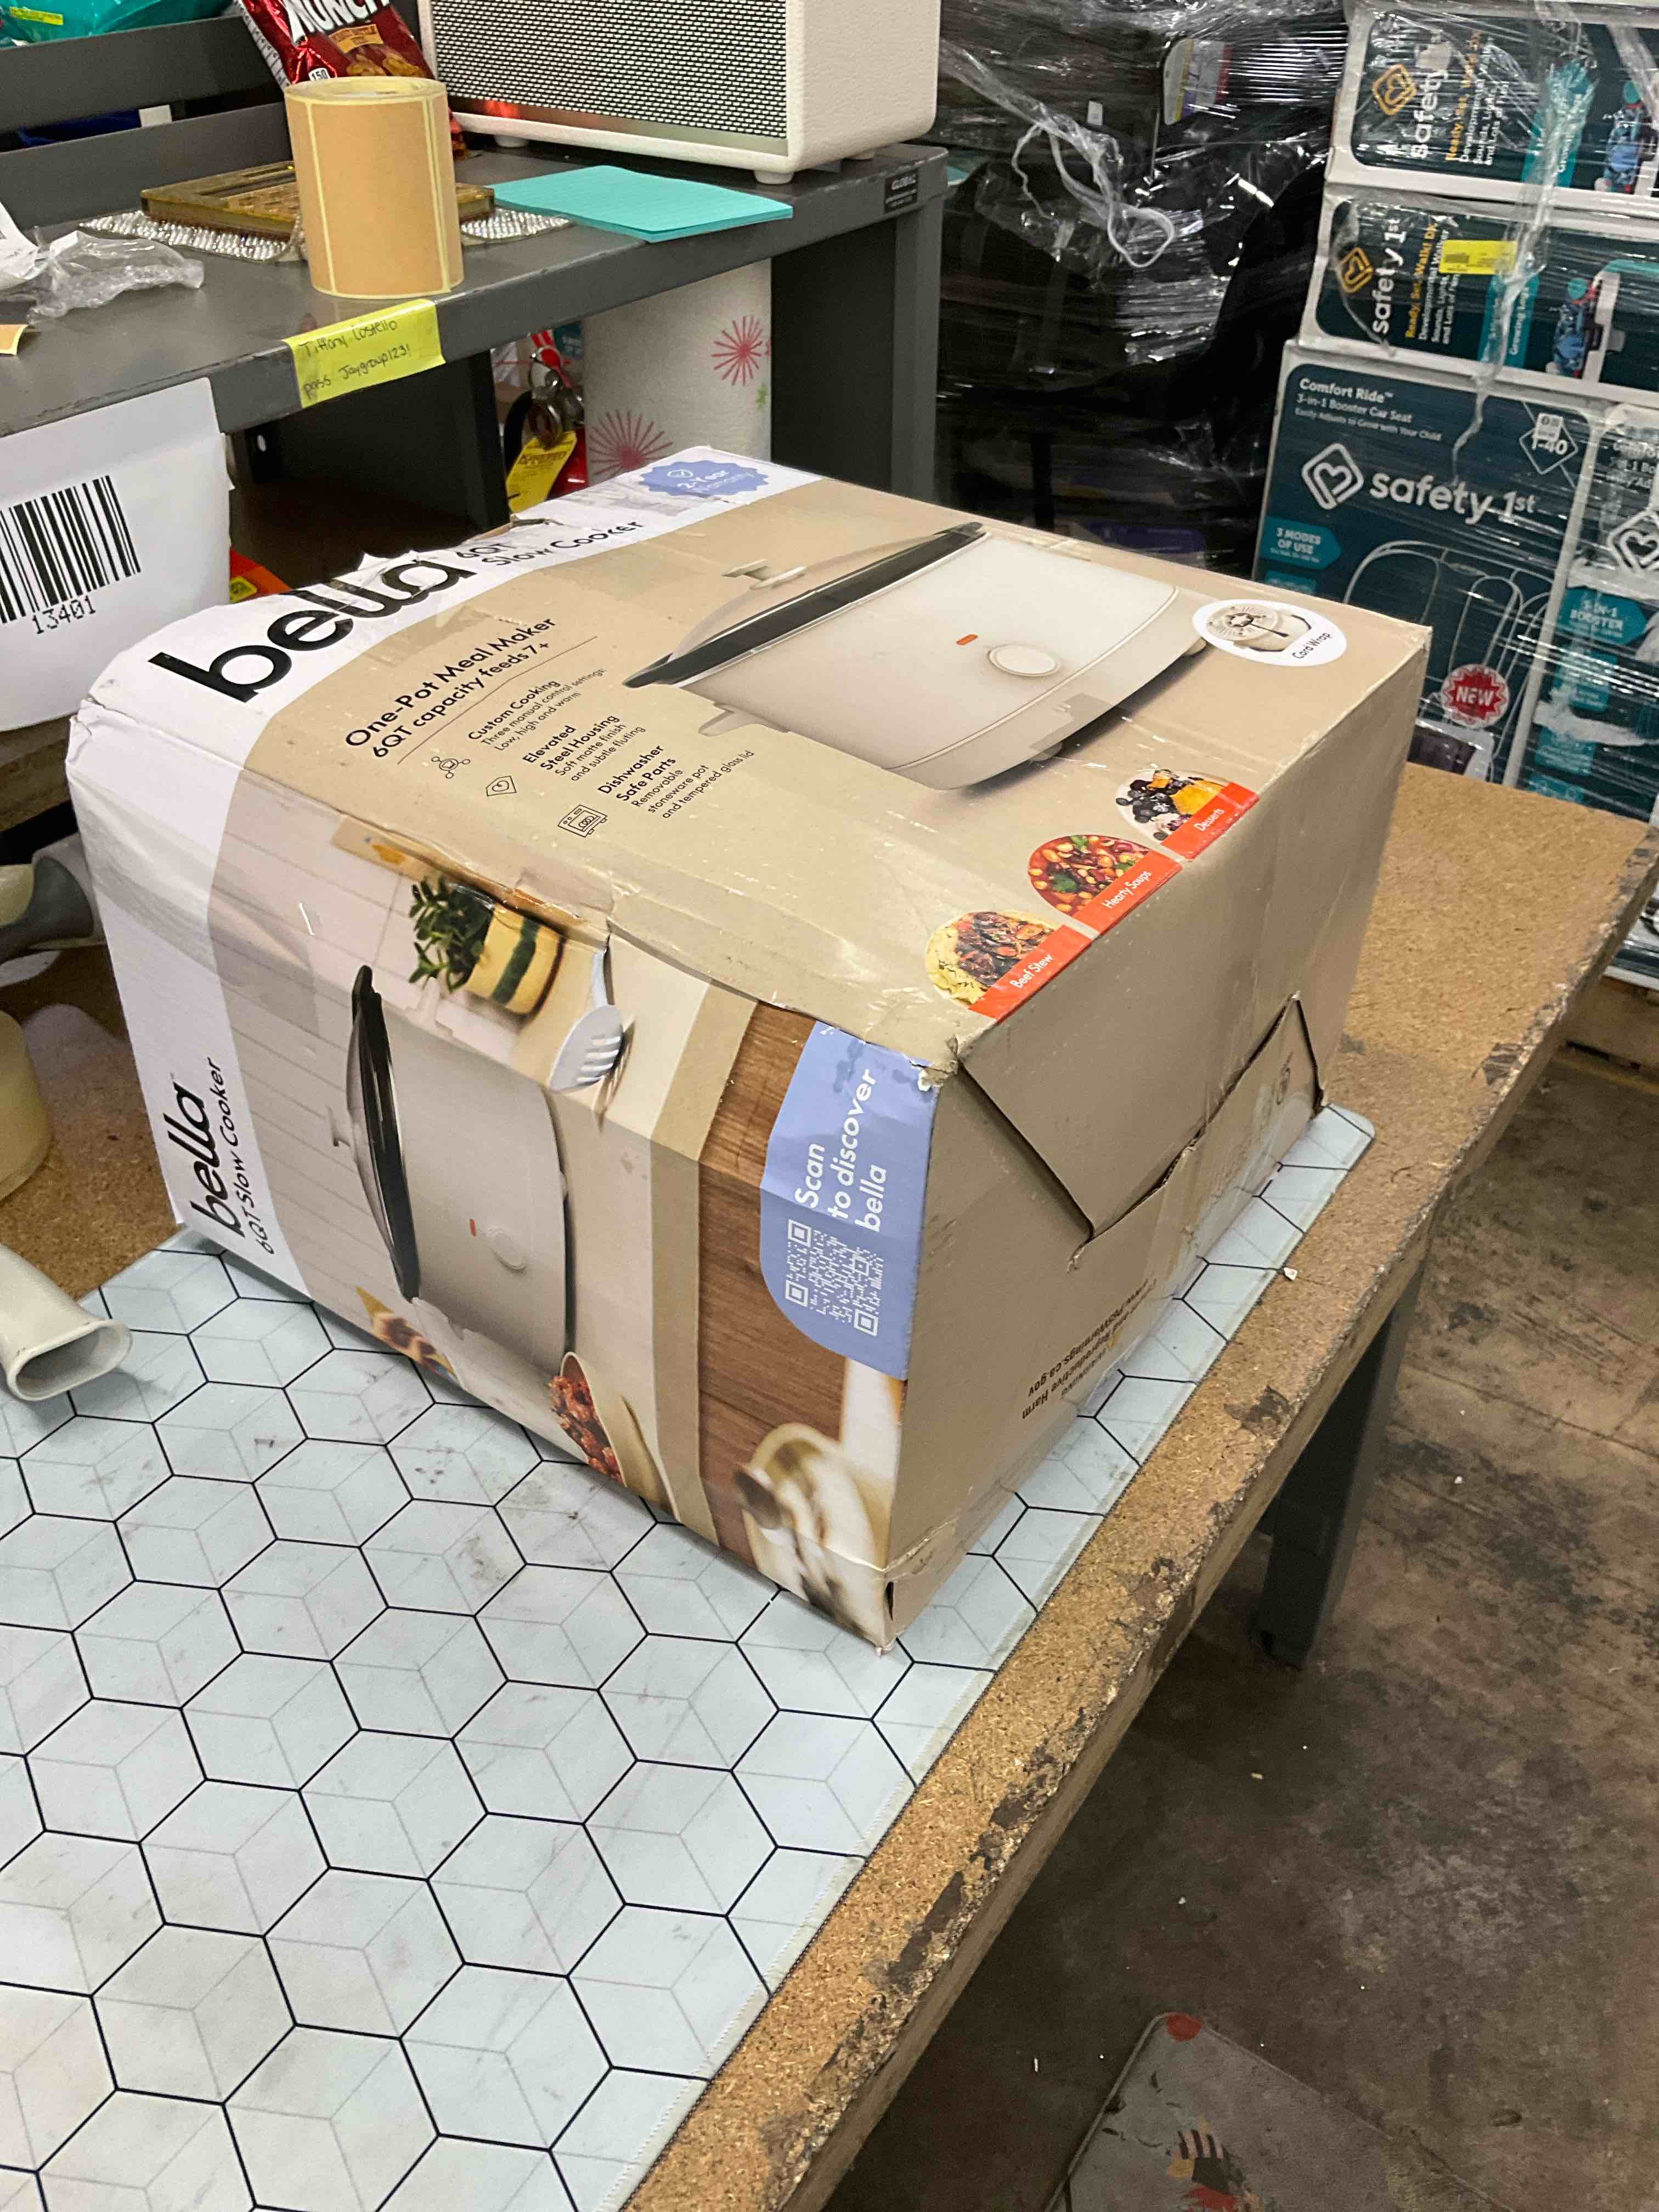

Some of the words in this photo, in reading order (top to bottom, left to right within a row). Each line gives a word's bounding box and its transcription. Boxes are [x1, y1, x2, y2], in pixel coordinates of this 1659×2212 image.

[1373, 247, 1404, 335] safety
[1297, 392, 1327, 408] 3-in-1
[1329, 399, 1368, 414] Booster
[1369, 407, 1388, 418] Car
[1390, 410, 1414, 423] Seat
[1299, 377, 1353, 398] Comfort
[1418, 430, 1442, 442] Child
[1369, 472, 1494, 526] safety
[1498, 491, 1537, 523] 1st
[456, 541, 517, 559] 6QT
[481, 549, 553, 566] Slow
[550, 521, 644, 549] Cooker
[1276, 527, 1284, 537] 3
[1284, 531, 1322, 545] MODES
[1278, 539, 1292, 549] OF
[1294, 542, 1314, 555] USE
[32, 595, 96, 634] 13401
[148, 559, 477, 703] bella
[1293, 644, 1314, 659] Cord
[1307, 631, 1331, 648] Wrap
[346, 681, 440, 746] One-Pot
[434, 647, 494, 683] Meal
[487, 618, 556, 652] Maker
[373, 725, 413, 758] 6QT
[413, 677, 485, 727] capacity
[480, 650, 529, 678] feeds
[1456, 685, 1494, 707] NEW
[469, 709, 514, 740] Custom
[510, 680, 561, 709] Cooking
[481, 727, 510, 746] Three
[509, 702, 543, 727] manual
[541, 685, 572, 703] control
[494, 735, 520, 751] Low,
[515, 720, 539, 736] high
[538, 706, 557, 721] and
[556, 692, 582, 707] warm
[523, 725, 577, 764] Elevated
[540, 747, 574, 770] Steel
[568, 715, 620, 748] Housing
[555, 761, 578, 776] Soft
[577, 741, 603, 761] matte
[601, 723, 627, 742] finish
[571, 765, 591, 781] and
[589, 746, 617, 768] subtle
[615, 726, 647, 748] fluting
[597, 745, 664, 794] Dishwasher
[616, 780, 647, 802] Safe
[642, 757, 676, 781] Parts
[631, 768, 684, 808] Removable
[647, 776, 695, 814] stoneware
[693, 764, 709, 780] pot
[662, 802, 681, 819] and
[679, 770, 721, 804] tempered
[720, 757, 744, 774] glass
[741, 750, 755, 760] lid
[1193, 808, 1226, 831] Desserts
[1102, 887, 1134, 909] Hearty
[1126, 870, 1152, 890] Soups
[1009, 968, 1036, 989] Beef
[1028, 953, 1054, 978] Stew
[206, 1057, 239, 1147] Cooker
[830, 1069, 878, 1187] discover
[162, 1081, 246, 1238] bella
[230, 1150, 256, 1209] Slow
[794, 1143, 825, 1209] Scan
[827, 1193, 853, 1221] to
[854, 1164, 887, 1232] bella
[241, 1205, 275, 1255] 6QT
[1022, 1389, 1049, 1419] Harm
